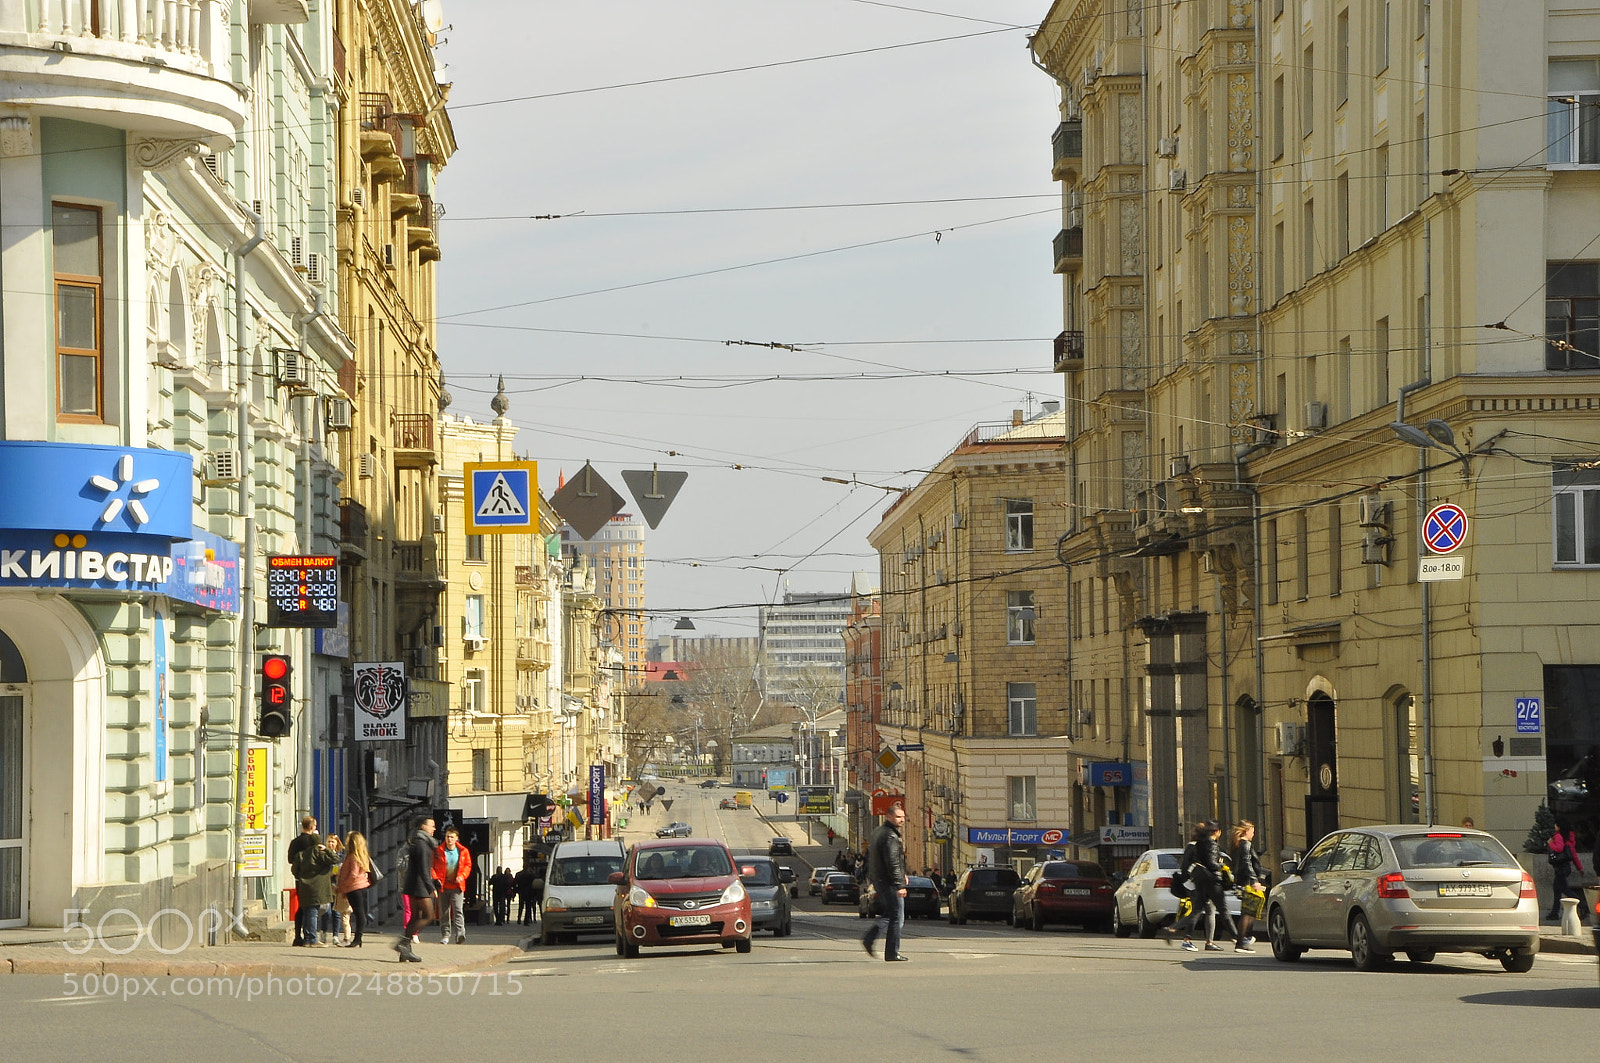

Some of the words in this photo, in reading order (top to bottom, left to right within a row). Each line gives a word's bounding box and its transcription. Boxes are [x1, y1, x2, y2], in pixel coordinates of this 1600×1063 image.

[0, 533, 173, 584] КИЇВСТАР
[271, 557, 302, 566] ОБМЕН
[303, 557, 335, 566] ВАЛЮТ
[271, 687, 284, 703] 12
[1517, 699, 1539, 721] 2/2
[363, 728, 398, 737] SMOKE
[247, 748, 256, 787] ОБМЕН
[1103, 770, 1123, 783] 55
[592, 766, 601, 818] MEGASPORT
[246, 790, 256, 829] ВАЛЮТ
